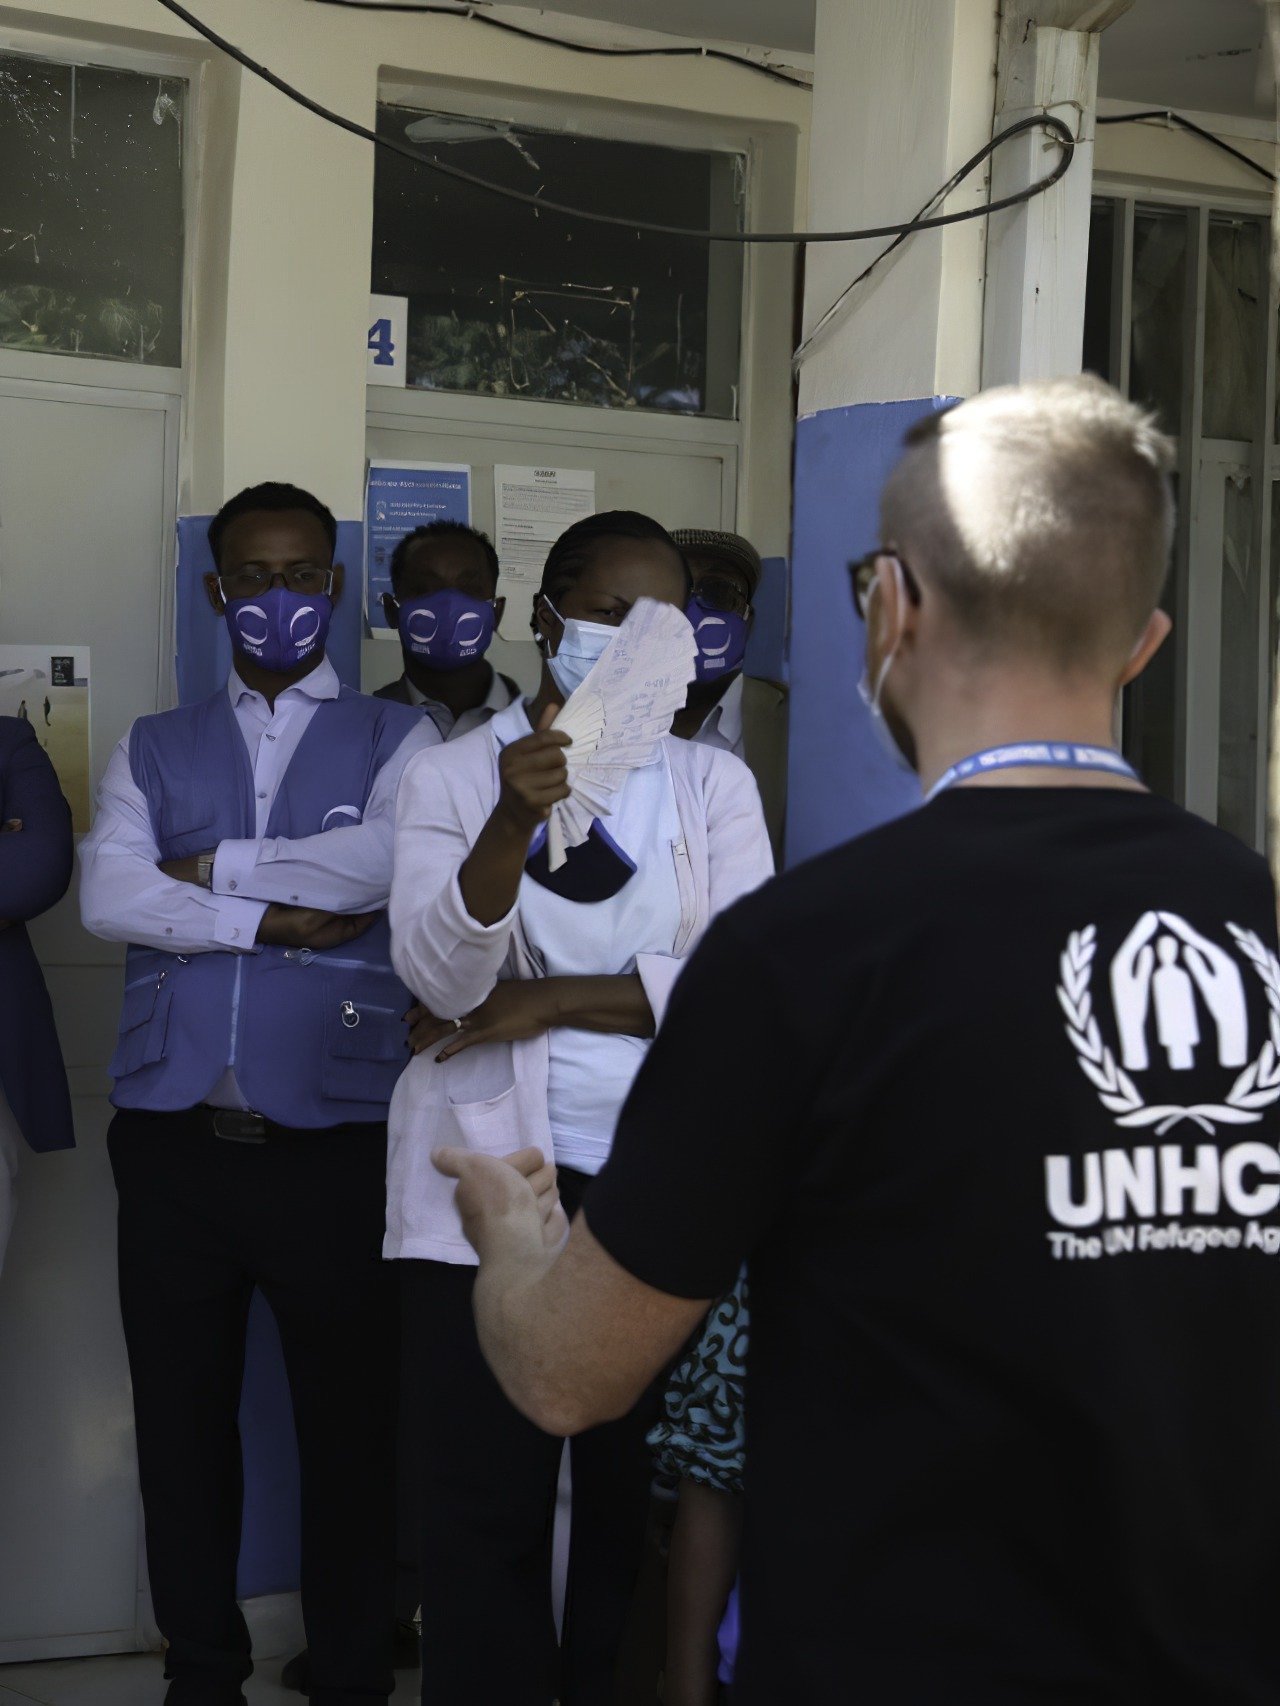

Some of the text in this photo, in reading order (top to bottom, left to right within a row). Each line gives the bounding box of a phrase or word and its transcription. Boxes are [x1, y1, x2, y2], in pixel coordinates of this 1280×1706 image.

[367, 318, 395, 366] 4
[1044, 1141, 1280, 1228] UNHC
[1045, 1231, 1102, 1260] The
[1138, 1221, 1243, 1254] Refugee
